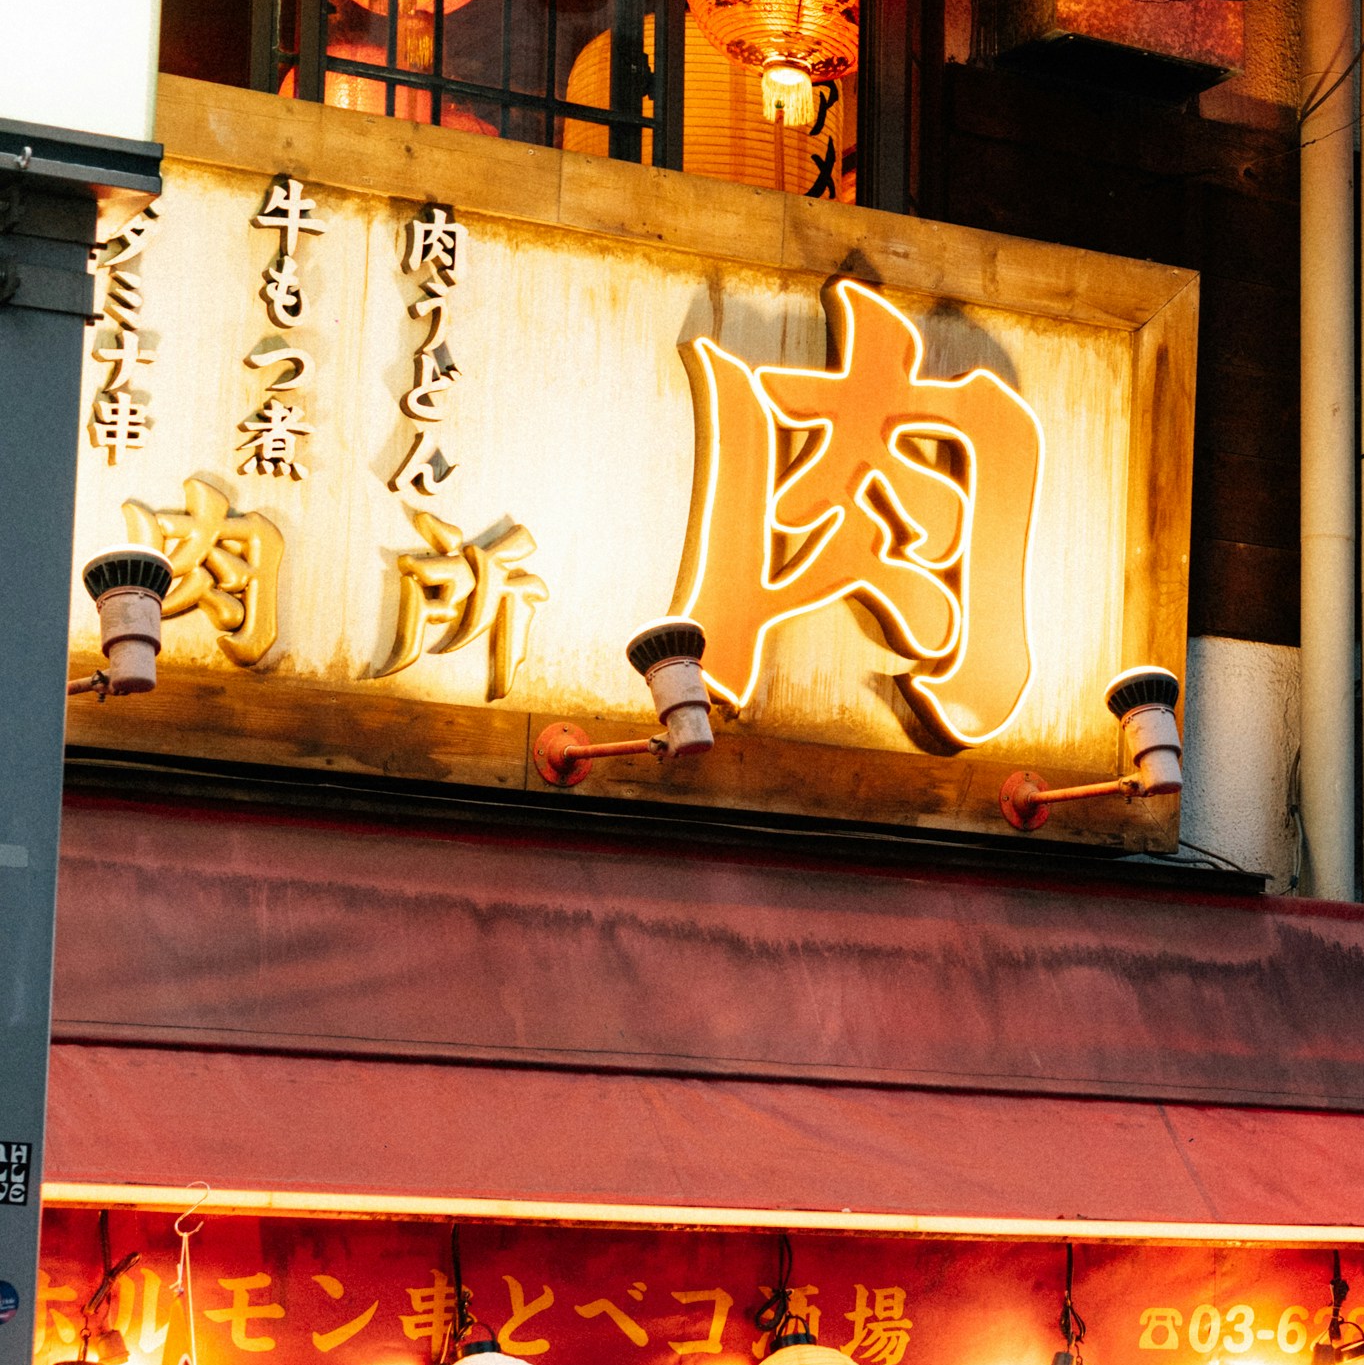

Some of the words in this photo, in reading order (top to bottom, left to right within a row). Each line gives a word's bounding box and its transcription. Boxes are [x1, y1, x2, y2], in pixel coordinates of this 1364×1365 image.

[92, 198, 160, 466] タミナ串
[236, 178, 325, 482] 牛もつ煮
[388, 206, 470, 496] 肉うどん
[672, 276, 1048, 748] 肉
